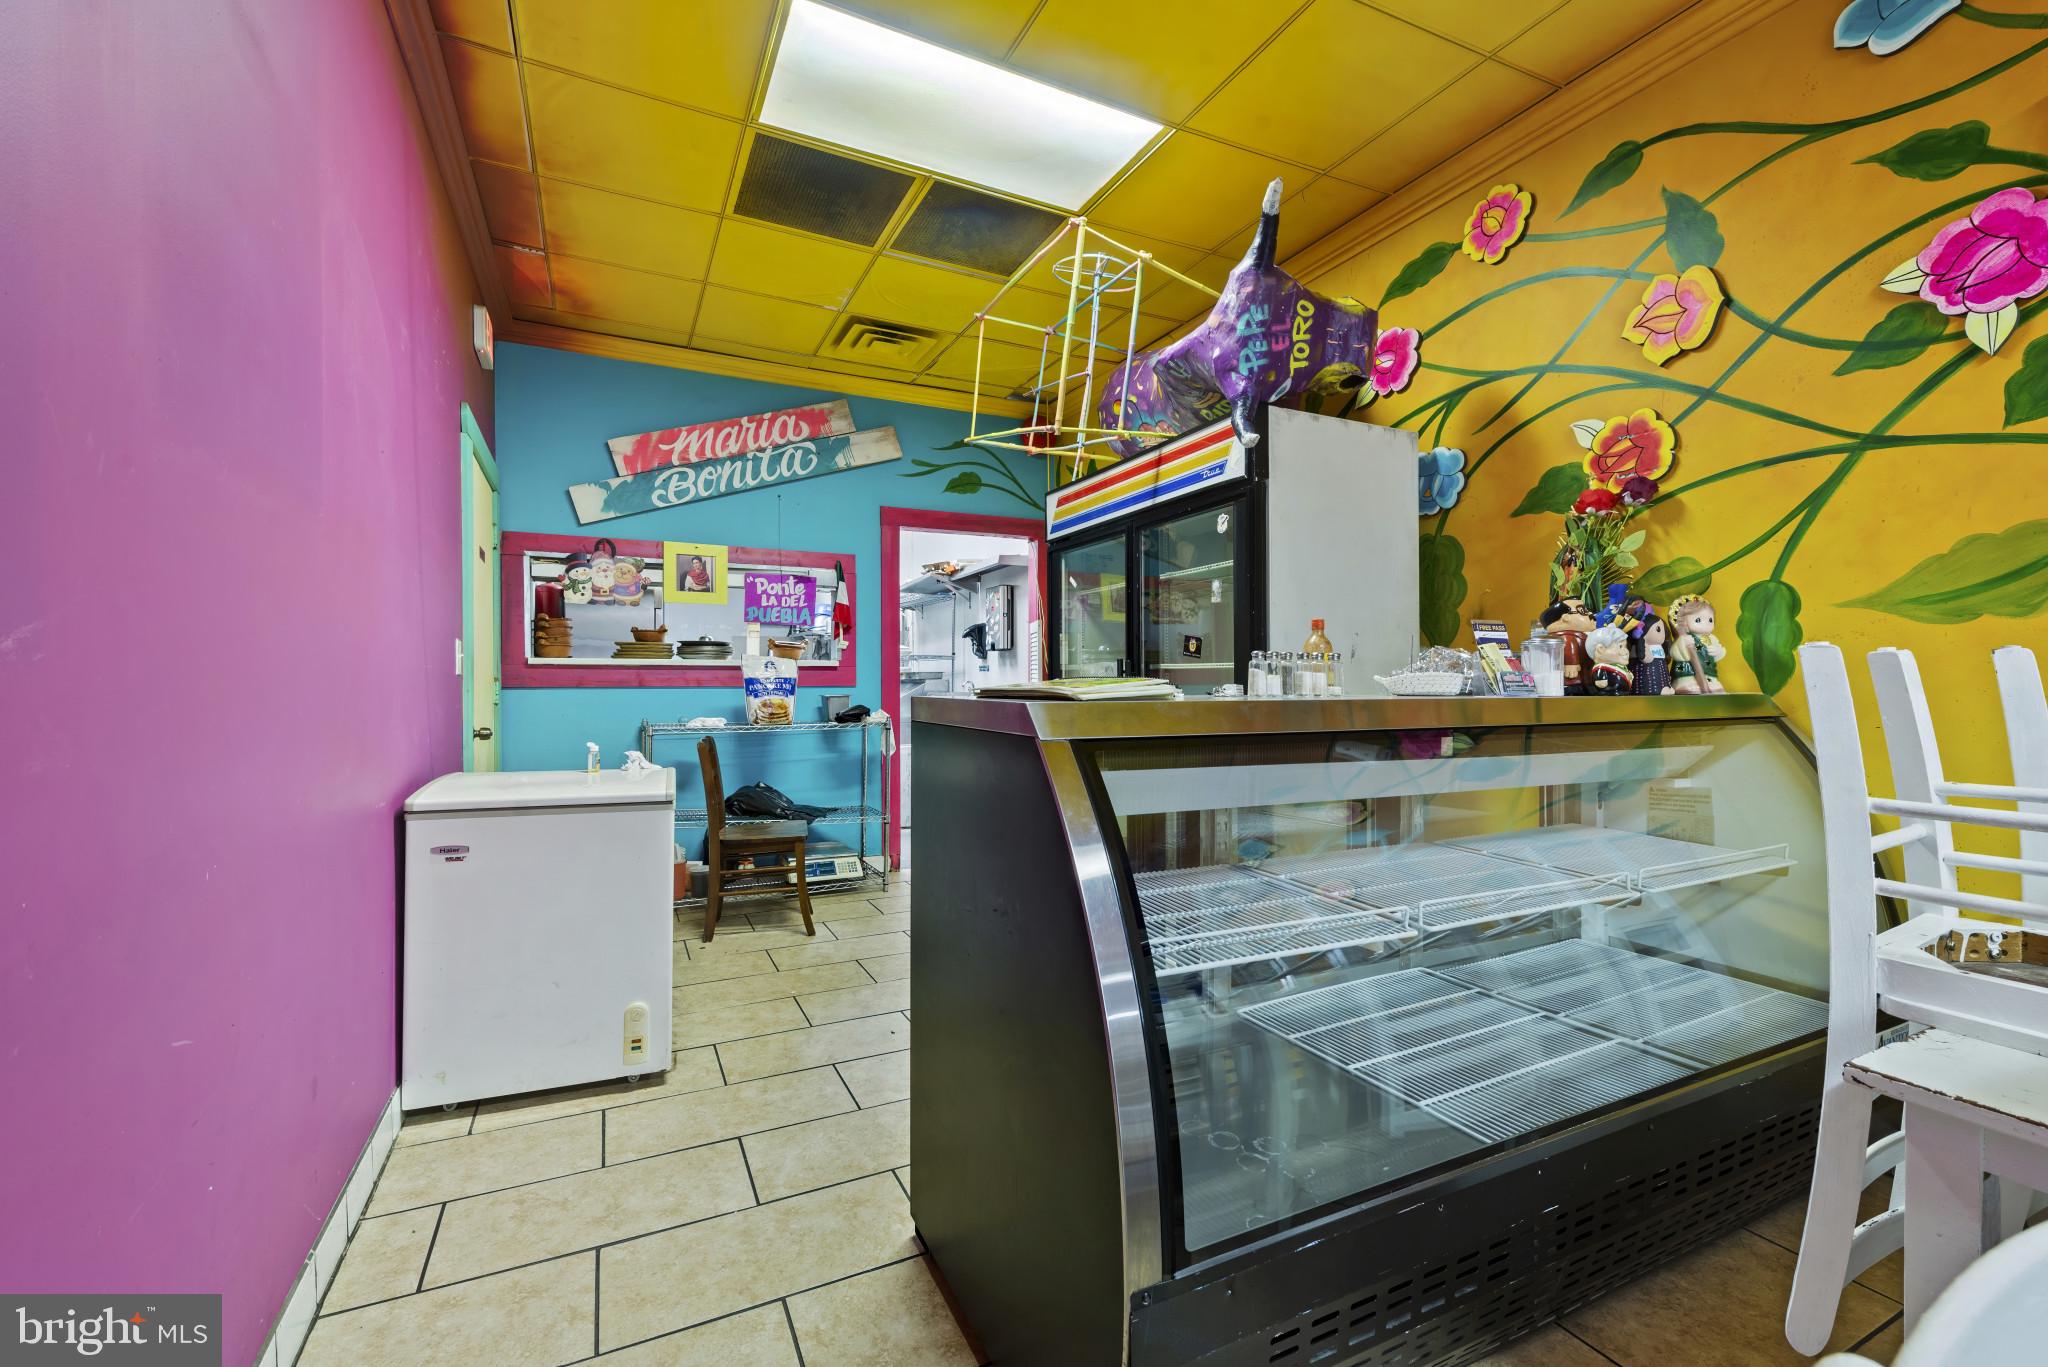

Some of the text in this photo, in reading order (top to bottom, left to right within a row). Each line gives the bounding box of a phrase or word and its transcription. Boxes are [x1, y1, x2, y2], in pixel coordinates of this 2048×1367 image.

[1236, 303, 1269, 377] PEPE
[1271, 317, 1291, 352] EL
[1289, 299, 1315, 377] TORO
[651, 440, 818, 508] Bonita
[746, 607, 812, 625] PUEBLA
[761, 594, 808, 607] LA DEL
